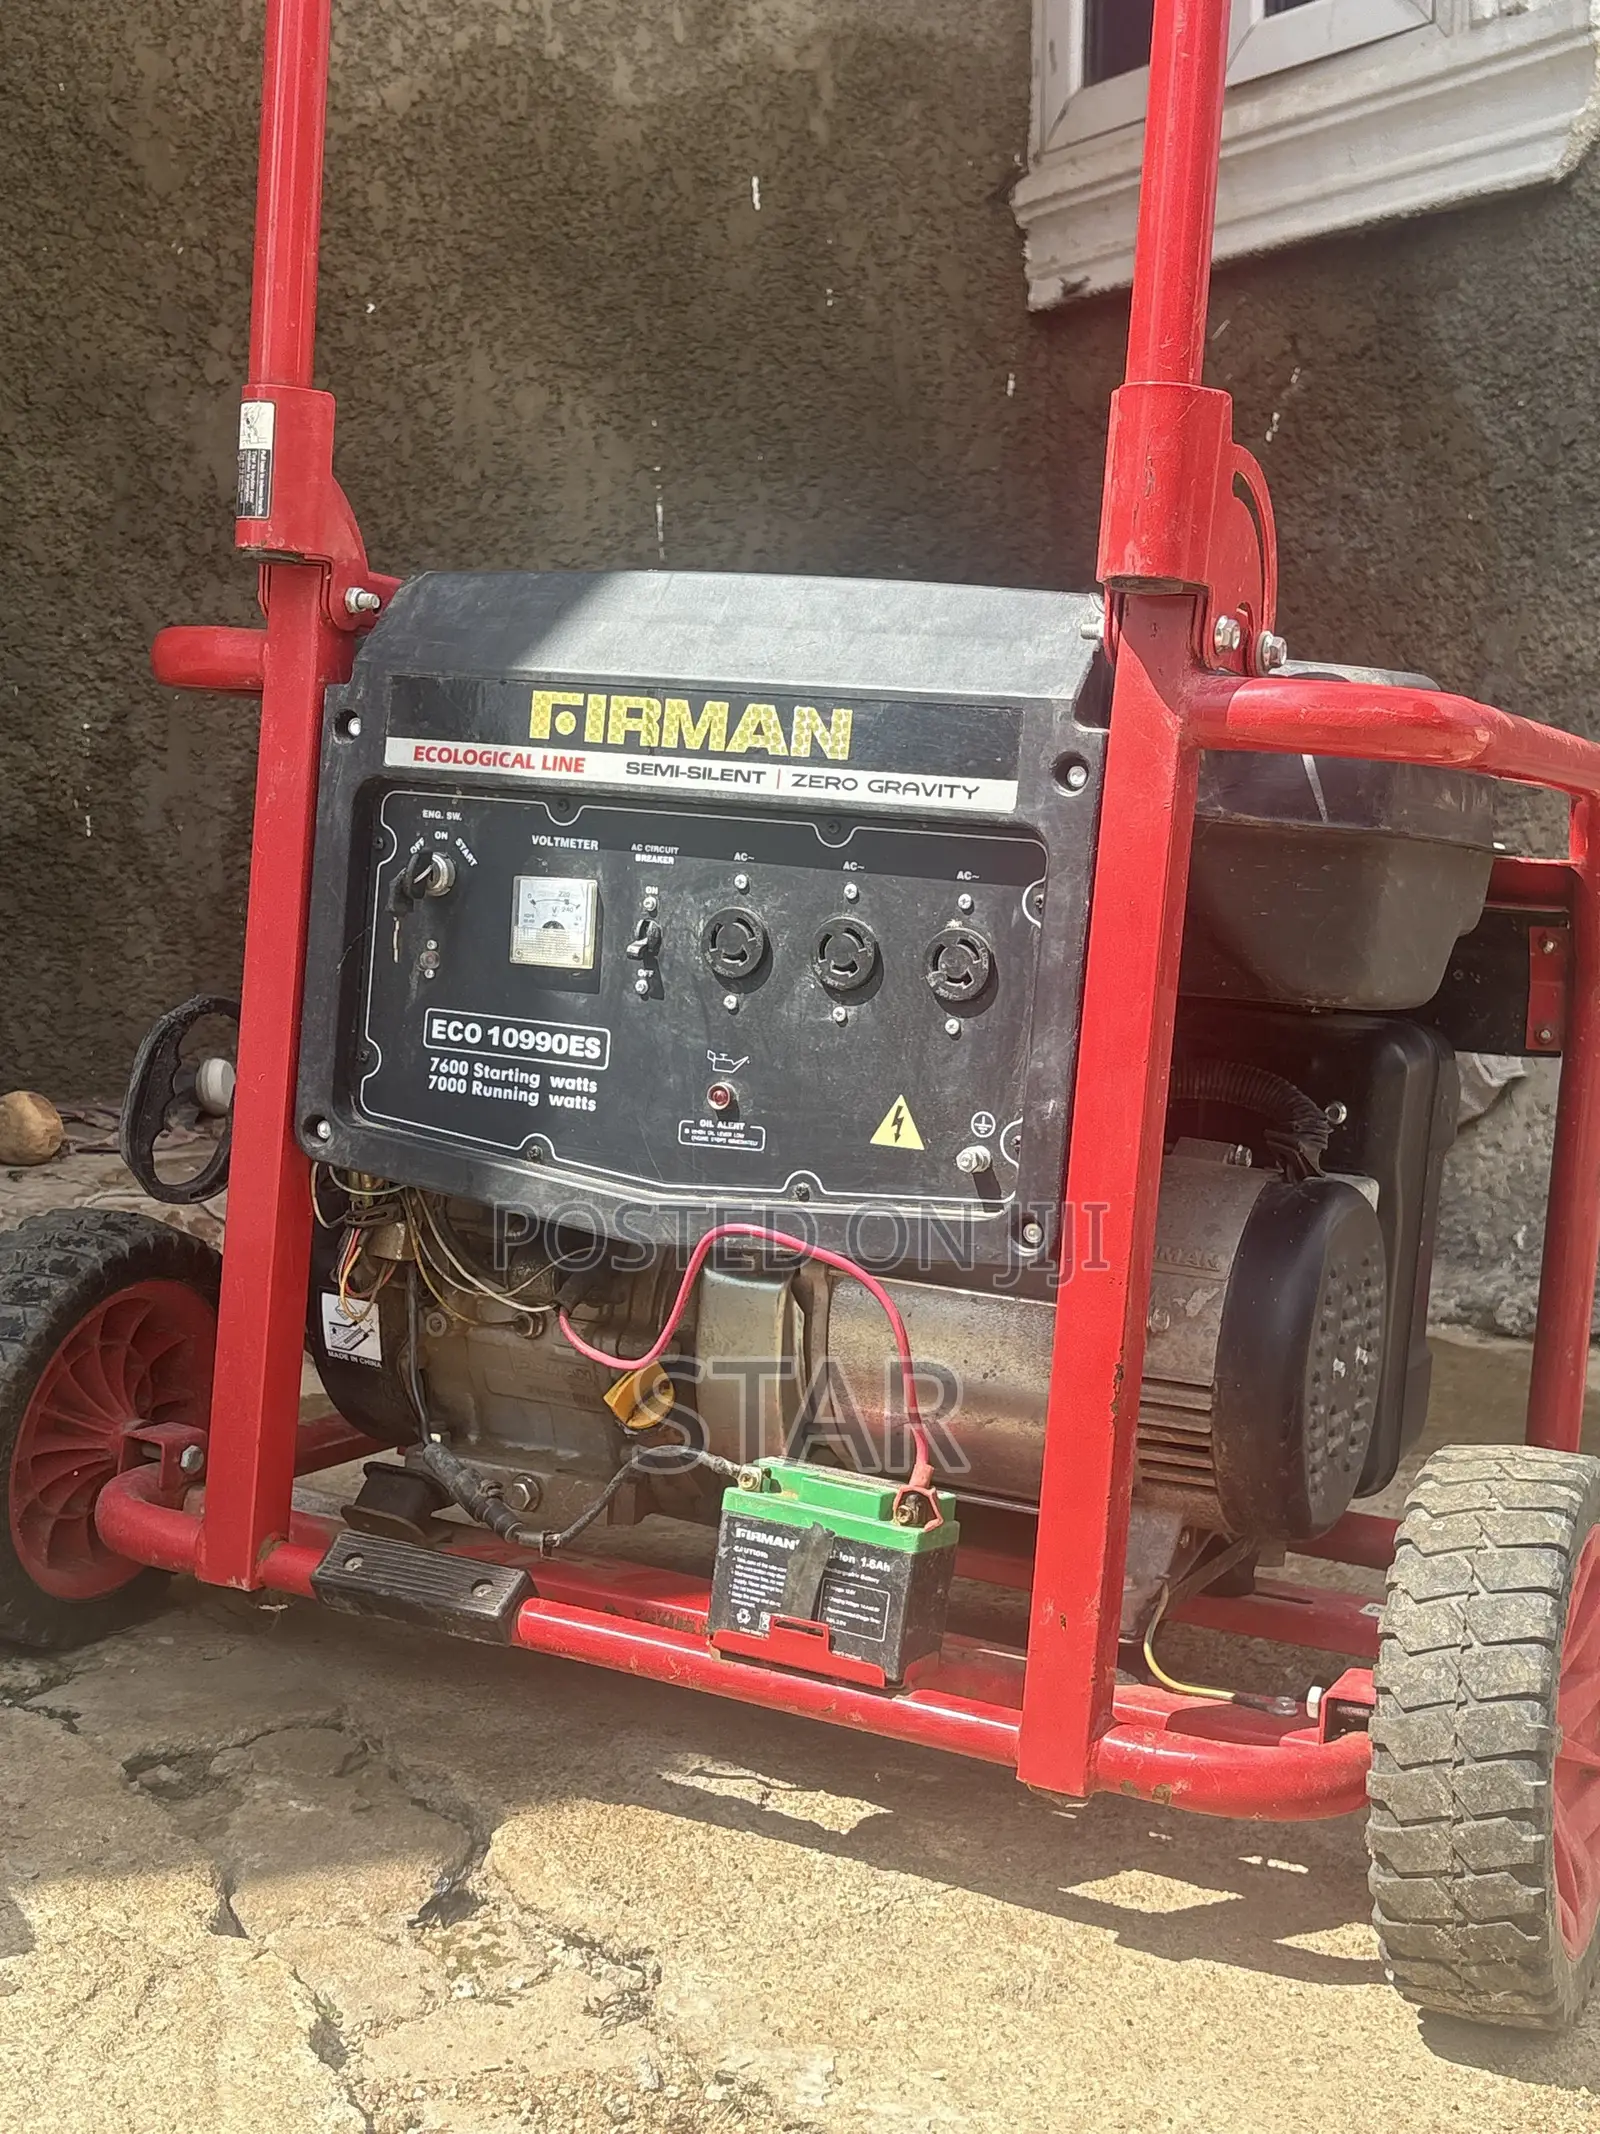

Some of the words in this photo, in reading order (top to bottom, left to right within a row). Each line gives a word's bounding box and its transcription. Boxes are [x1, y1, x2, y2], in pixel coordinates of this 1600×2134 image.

[529, 690, 854, 760] FIRMAN
[413, 745, 535, 770] ECOLOGICAL
[542, 755, 586, 773] LINE
[626, 761, 766, 785] SEMI-SILENT
[792, 774, 858, 791] ZERO
[868, 779, 980, 800] GRAVITY
[422, 809, 444, 819] ENG.
[446, 811, 462, 821] SW.
[434, 831, 448, 840] ON
[532, 835, 599, 851] VOLTMETER
[455, 838, 478, 867] START
[645, 845, 679, 855] CIRCUIT
[635, 854, 675, 865] BREAKER
[645, 886, 658, 894] ON
[638, 969, 654, 977] OFF
[431, 1018, 482, 1044] ECO
[487, 1026, 601, 1059] 10990ES
[429, 1057, 469, 1076] 7600
[473, 1063, 541, 1088] Starting
[550, 1075, 598, 1093] watts
[428, 1075, 467, 1094] 7000
[472, 1080, 540, 1107] Running
[549, 1093, 597, 1112] watts
[699, 1119, 714, 1128] OIL
[717, 1121, 745, 1130] ALERT
[328, 1350, 349, 1361] MADE
[359, 1357, 382, 1368] CHINA
